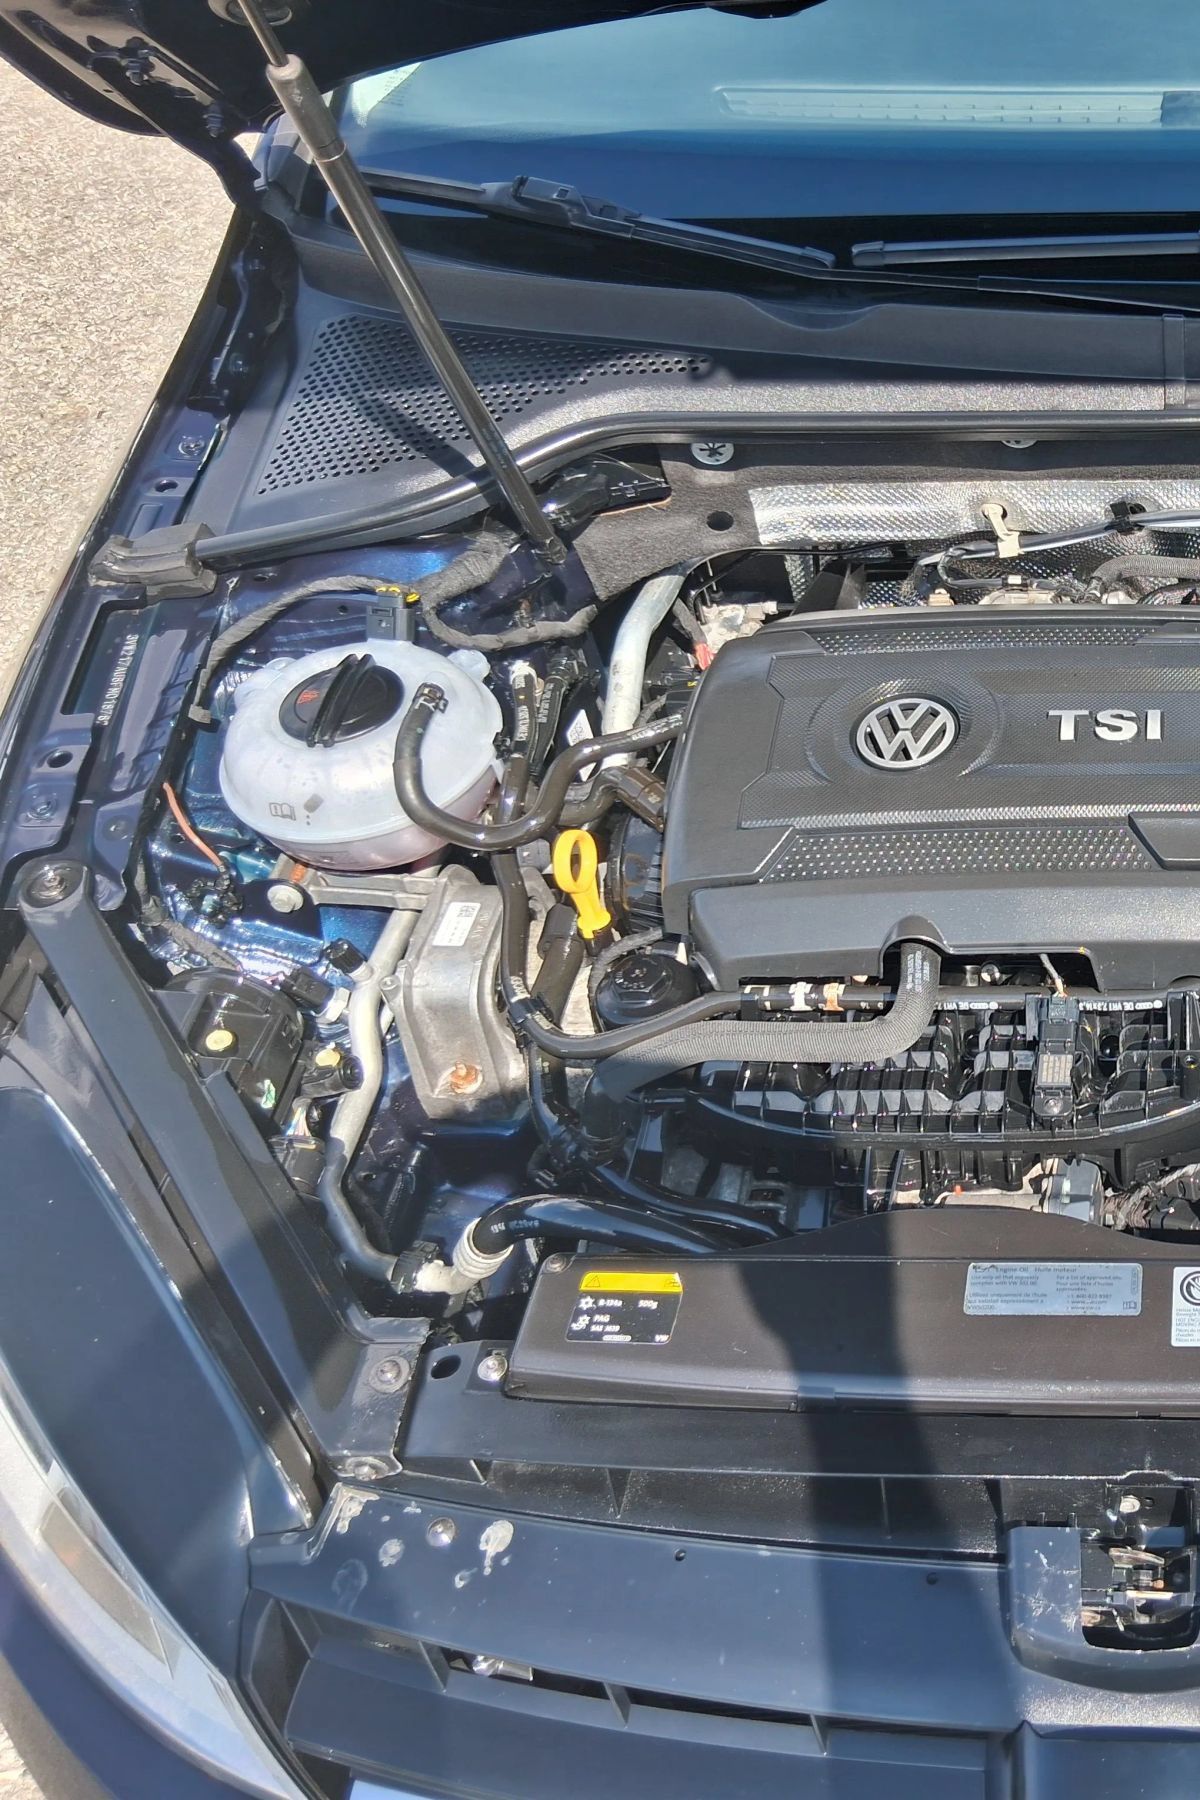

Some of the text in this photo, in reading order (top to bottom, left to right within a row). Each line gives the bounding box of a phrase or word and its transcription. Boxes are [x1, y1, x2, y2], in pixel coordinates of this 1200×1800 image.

[1048, 708, 1162, 741] TSI
[638, 1299, 659, 1310] 500g
[593, 1313, 611, 1323] PAG
[590, 1324, 604, 1332] SAE
[654, 1333, 670, 1342] VW
